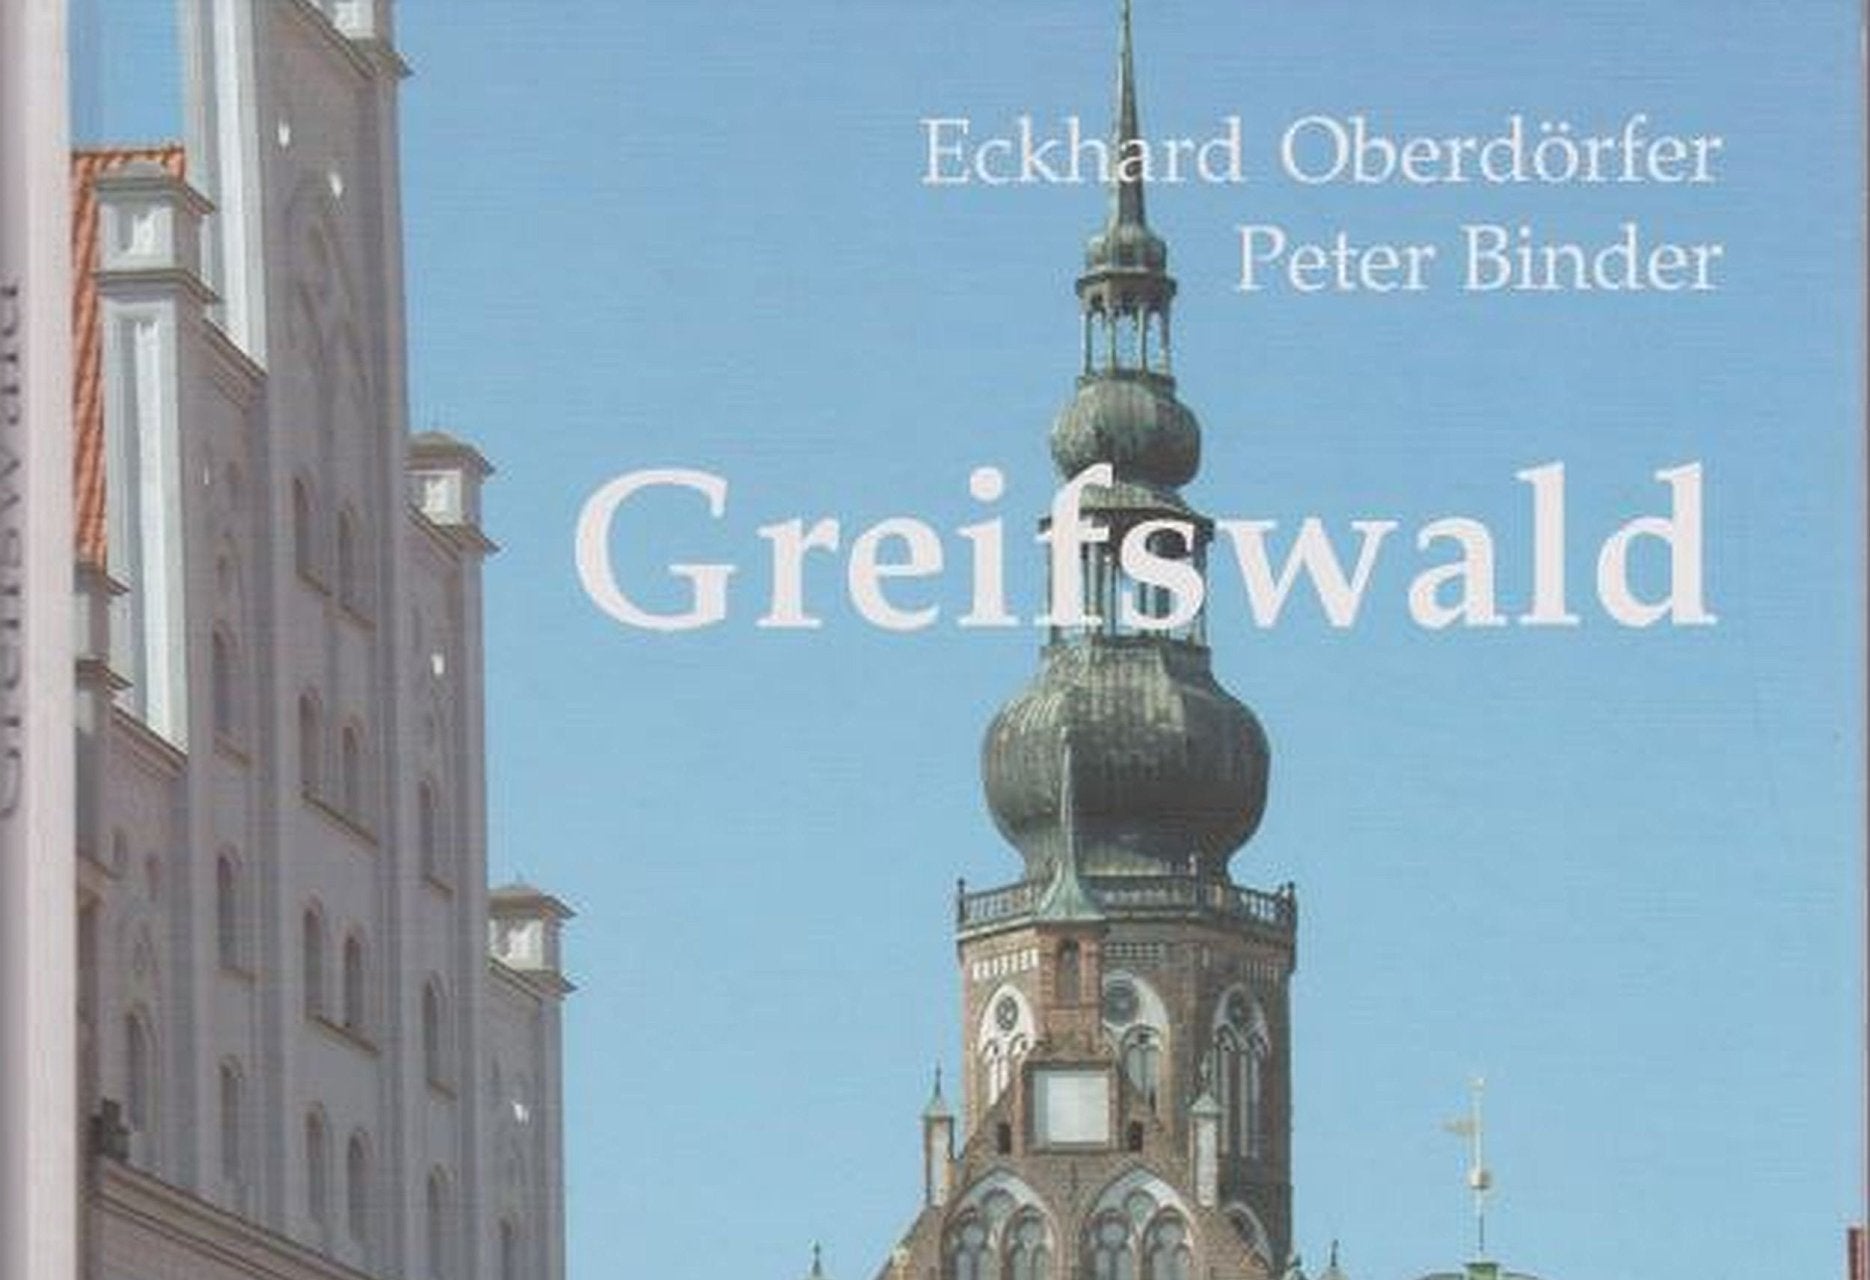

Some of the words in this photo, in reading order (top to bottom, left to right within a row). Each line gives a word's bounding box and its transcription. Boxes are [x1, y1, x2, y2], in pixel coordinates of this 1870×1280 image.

[923, 116, 1242, 183] Eckhard
[1281, 115, 1722, 183] Oberdörfer
[1240, 226, 1435, 291] Peter
[1466, 223, 1722, 290] Binder
[575, 462, 1717, 634] Greifswald
